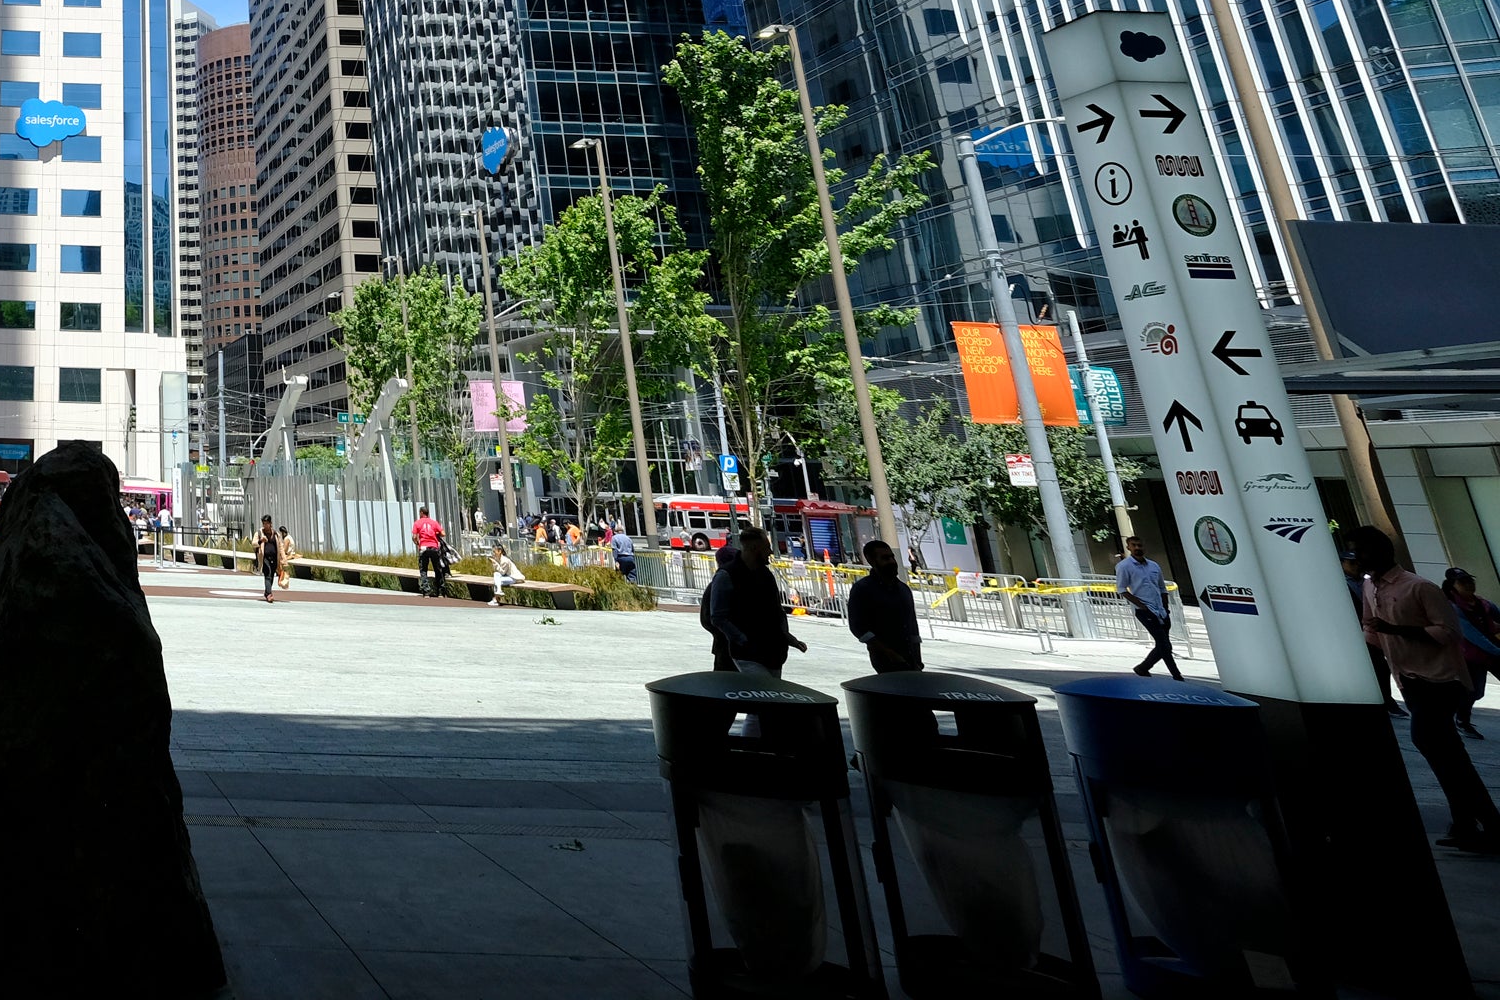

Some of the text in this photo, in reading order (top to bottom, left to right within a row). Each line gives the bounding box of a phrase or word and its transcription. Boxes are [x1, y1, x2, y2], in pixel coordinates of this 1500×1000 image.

[25, 115, 80, 128] salesforce
[1184, 253, 1231, 264] samTrans
[961, 327, 981, 337] OUR
[957, 337, 992, 347] STORIED
[964, 346, 986, 355] NEW
[1026, 348, 1058, 359] MOTHS
[961, 355, 1007, 365] NEIGHBOR-
[970, 365, 998, 374] HOOD
[1090, 373, 1112, 418] BABSON
[1102, 373, 1125, 418] COLLEGE
[723, 457, 735, 471] P
[1243, 481, 1311, 493] Greyhound
[1207, 583, 1254, 596] samTrans
[725, 690, 817, 703] COMPOST
[939, 691, 1004, 702] TRASH
[1139, 693, 1235, 706] RECYCLE
